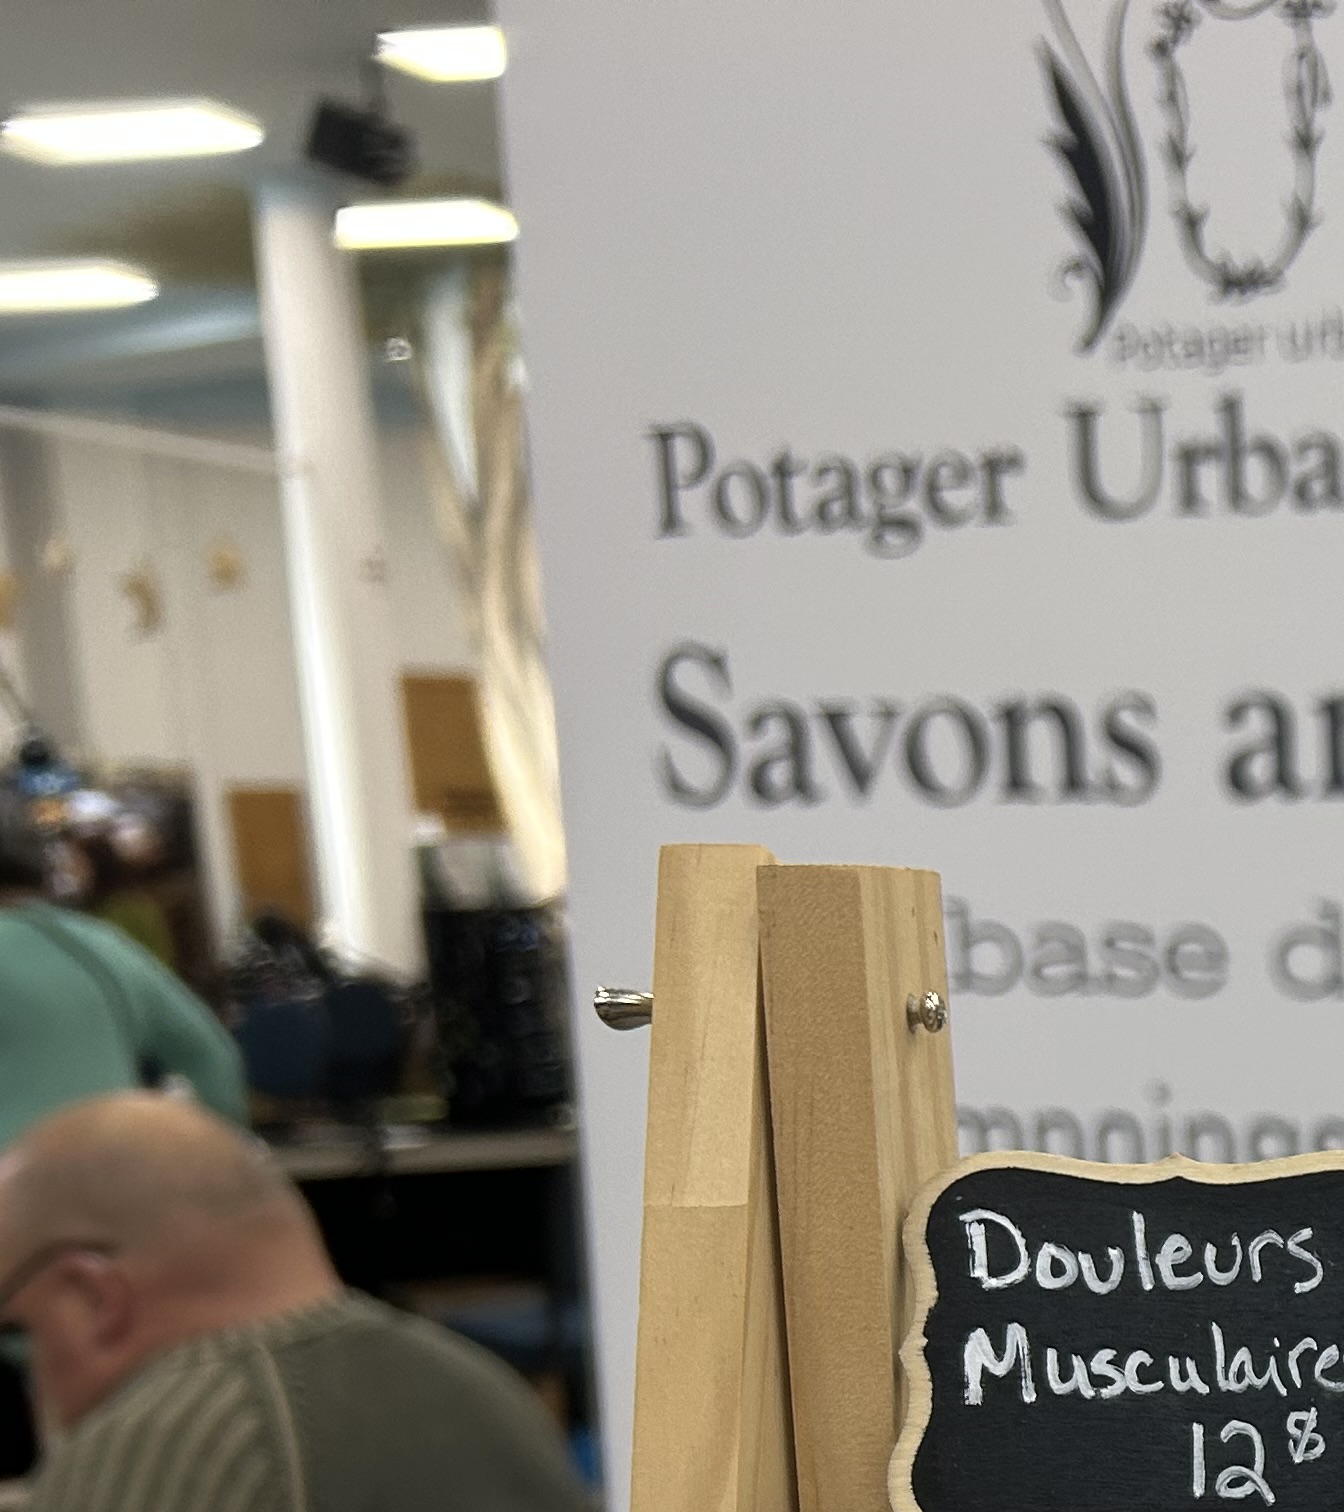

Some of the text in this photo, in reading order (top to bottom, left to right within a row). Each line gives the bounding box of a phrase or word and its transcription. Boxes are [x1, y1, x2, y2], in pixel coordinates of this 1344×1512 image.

[1108, 319, 1267, 376] Potager
[645, 420, 1025, 560] Potager
[652, 637, 1167, 808] Savons
[947, 897, 1230, 1002] base
[959, 1209, 1323, 1294] Douleurs
